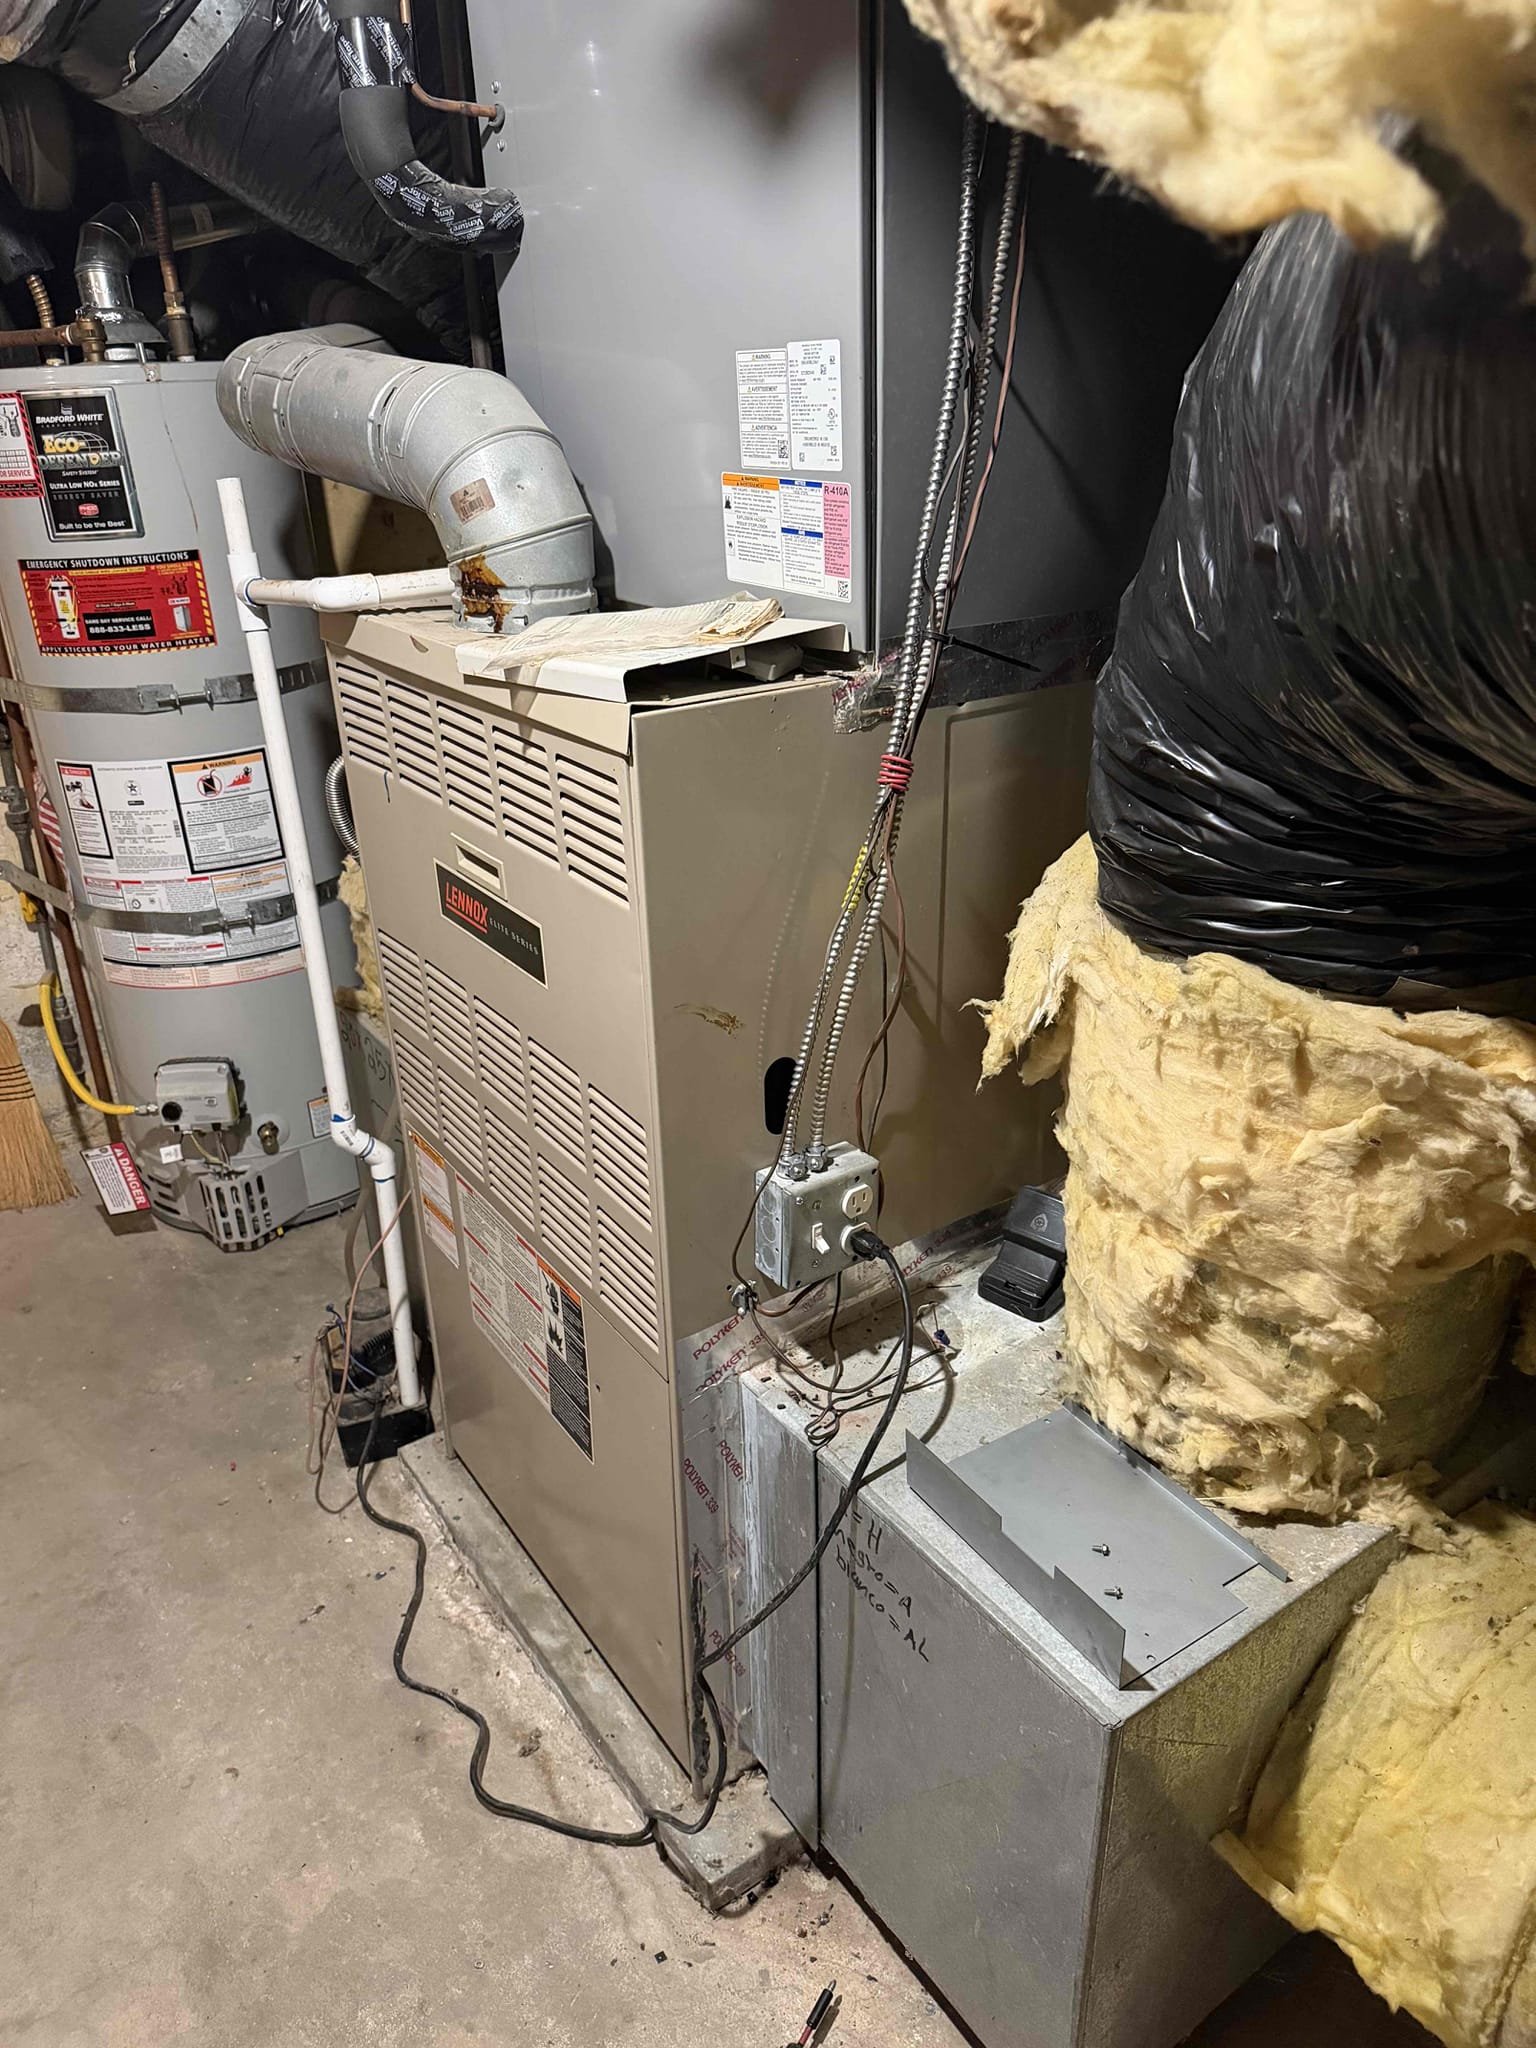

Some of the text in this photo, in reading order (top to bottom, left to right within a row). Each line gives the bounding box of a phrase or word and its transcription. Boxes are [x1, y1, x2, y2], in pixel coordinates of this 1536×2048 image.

[36, 415, 76, 425] BRADFORD
[76, 413, 104, 422] WHITE
[37, 451, 122, 469] DEFENDER
[824, 485, 849, 497] R-410A
[83, 521, 94, 529] be
[26, 551, 189, 569] EMERGENCY SHUTDOWN INSTRUCTIONS
[64, 645, 98, 653] STICKER
[113, 643, 139, 651] YOUR
[140, 641, 172, 650] WATER
[174, 636, 211, 646] HEATER
[209, 759, 237, 768] WARNING
[445, 881, 489, 927] LENNOX
[511, 931, 539, 955] SERIES
[118, 1157, 147, 1204] DANGER
[683, 1457, 719, 1514] POLYKEN 339
[867, 1518, 882, 1555] H
